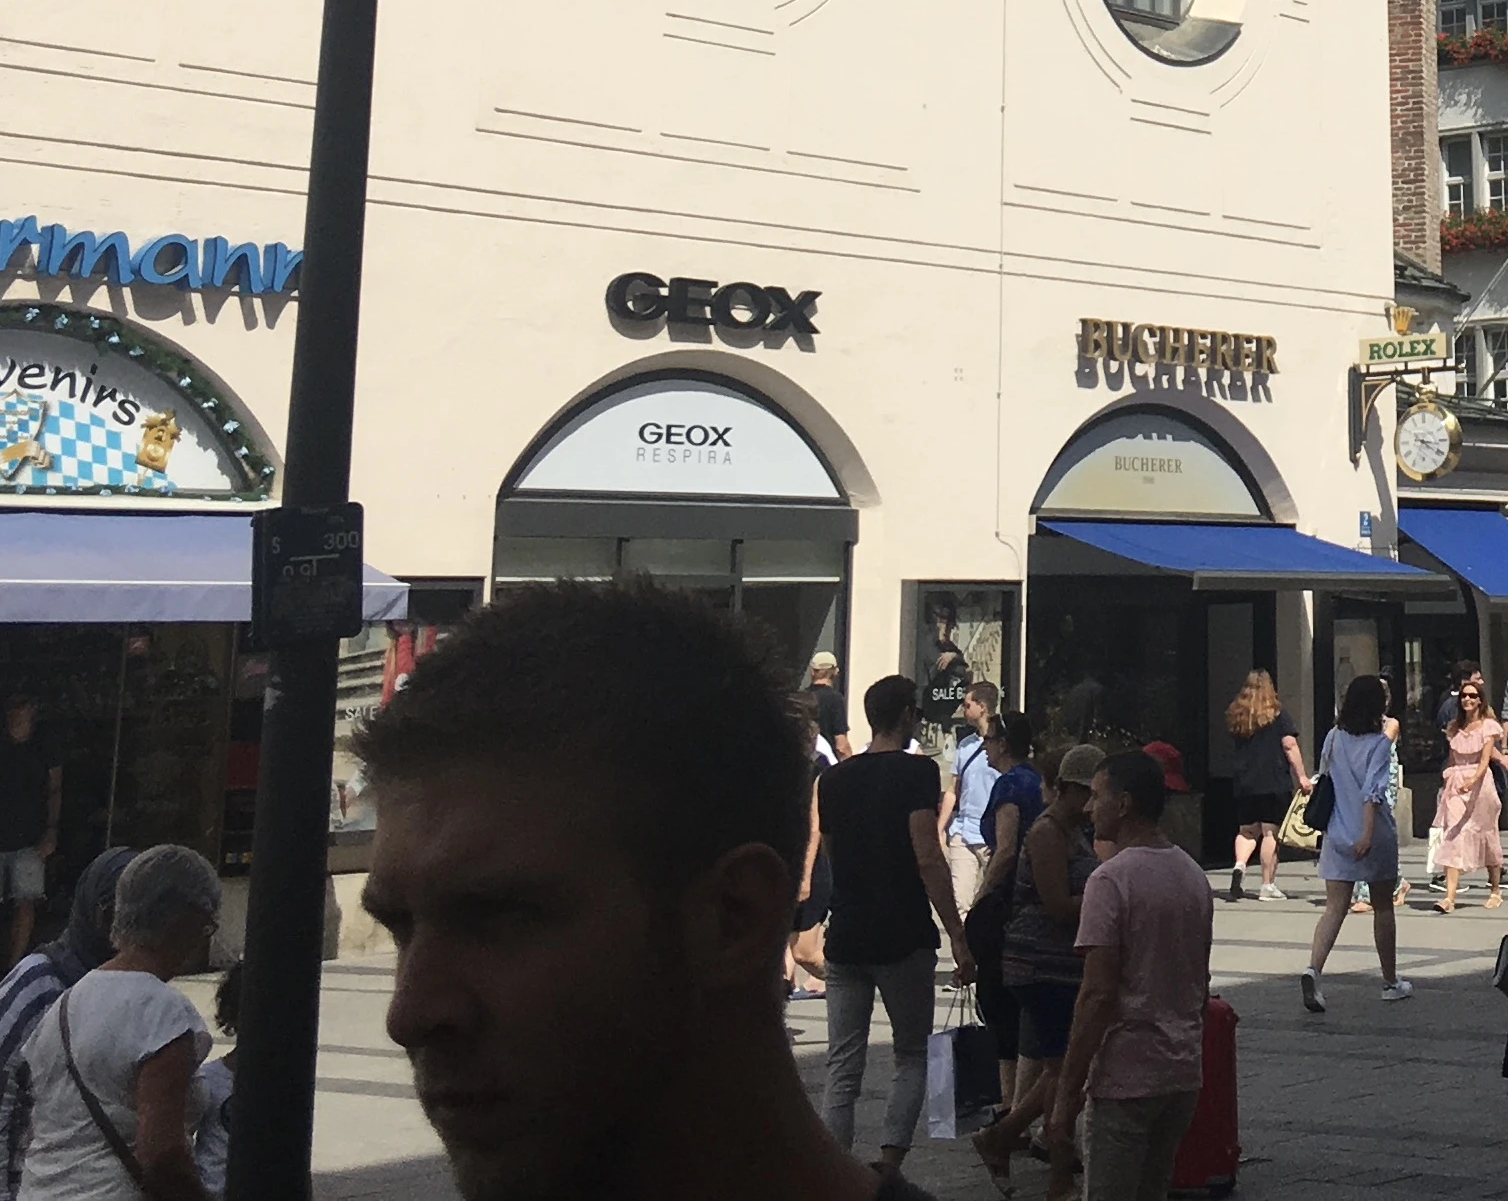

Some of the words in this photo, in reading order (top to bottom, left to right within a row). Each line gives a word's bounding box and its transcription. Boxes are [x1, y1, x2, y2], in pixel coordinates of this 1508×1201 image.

[605, 271, 823, 335] GEOX
[1078, 317, 1281, 375] BUCHERER
[1368, 338, 1437, 361] ROLEX
[638, 422, 733, 448] GEOX
[636, 447, 733, 465] RESPIRA
[1114, 455, 1184, 475] BUCHERER
[323, 530, 360, 550] 300
[932, 687, 955, 701] SALE
